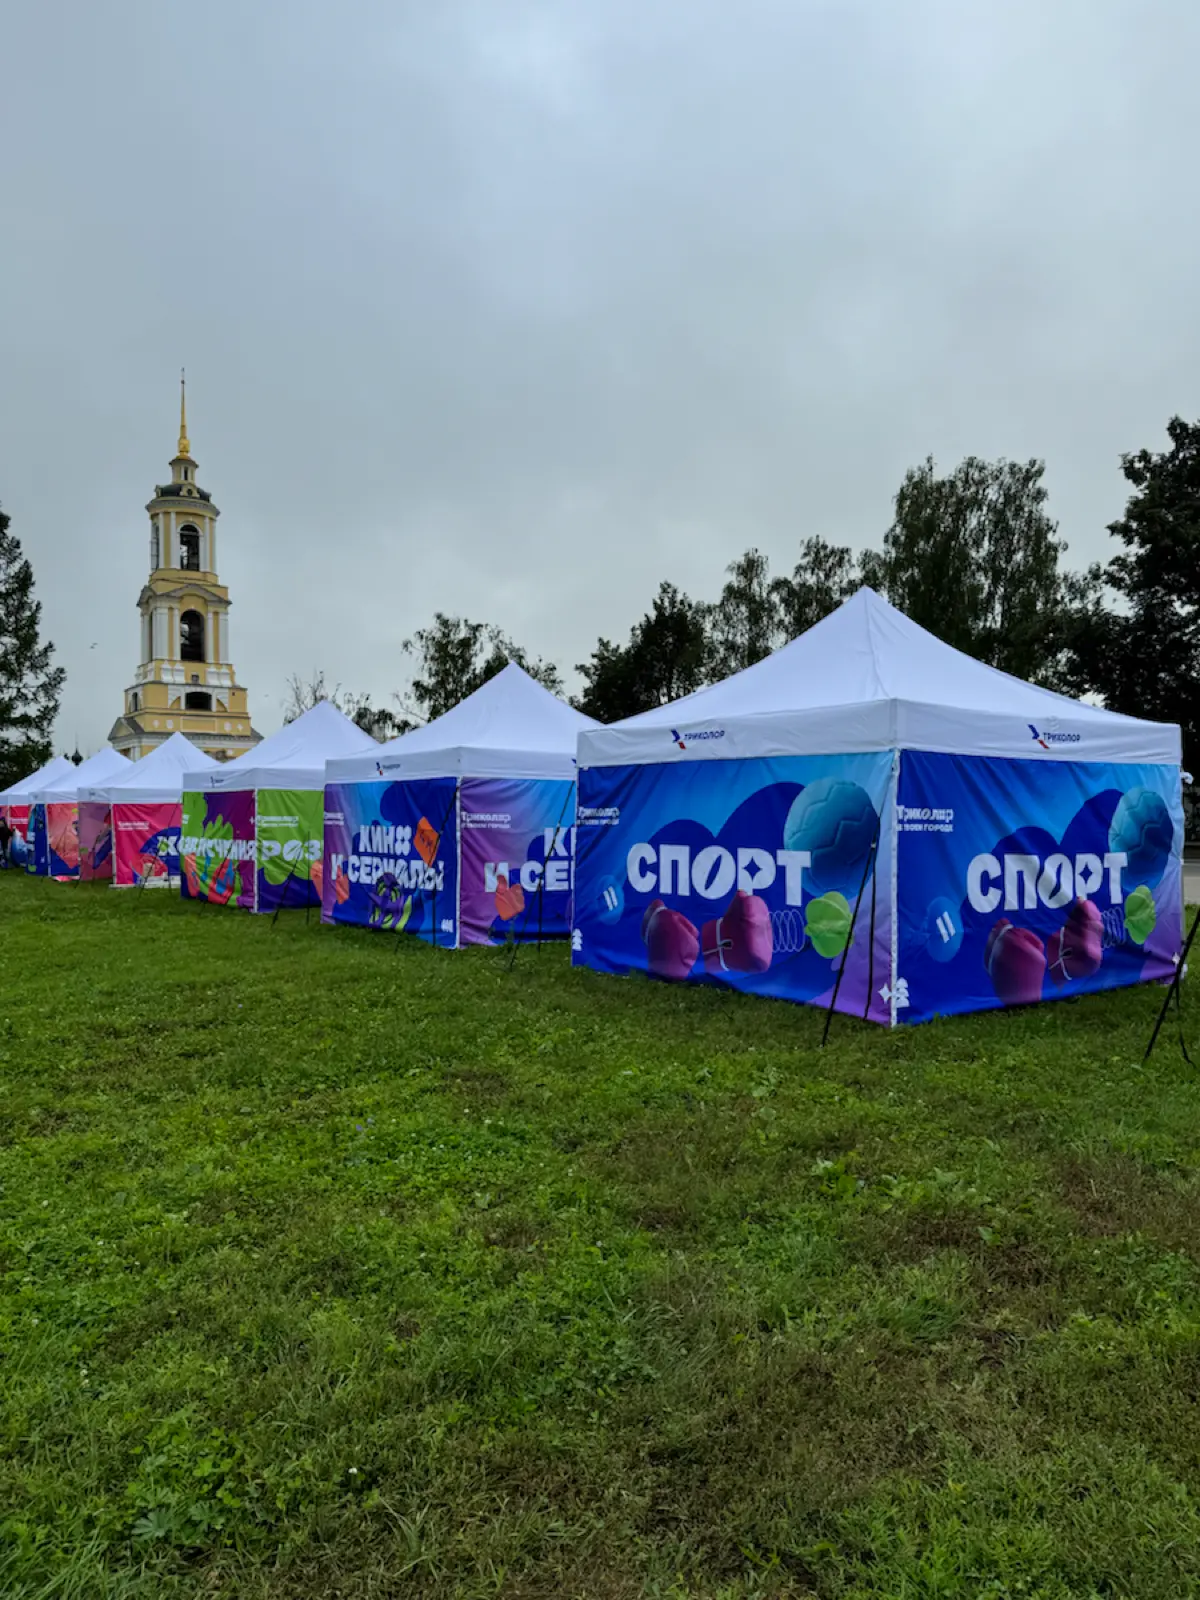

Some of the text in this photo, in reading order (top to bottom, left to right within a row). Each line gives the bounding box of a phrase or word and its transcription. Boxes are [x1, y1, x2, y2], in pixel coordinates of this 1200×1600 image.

[520, 860, 576, 892] СЕ
[626, 842, 811, 907] СПОРТ
[966, 852, 1128, 914] СПОРТ
